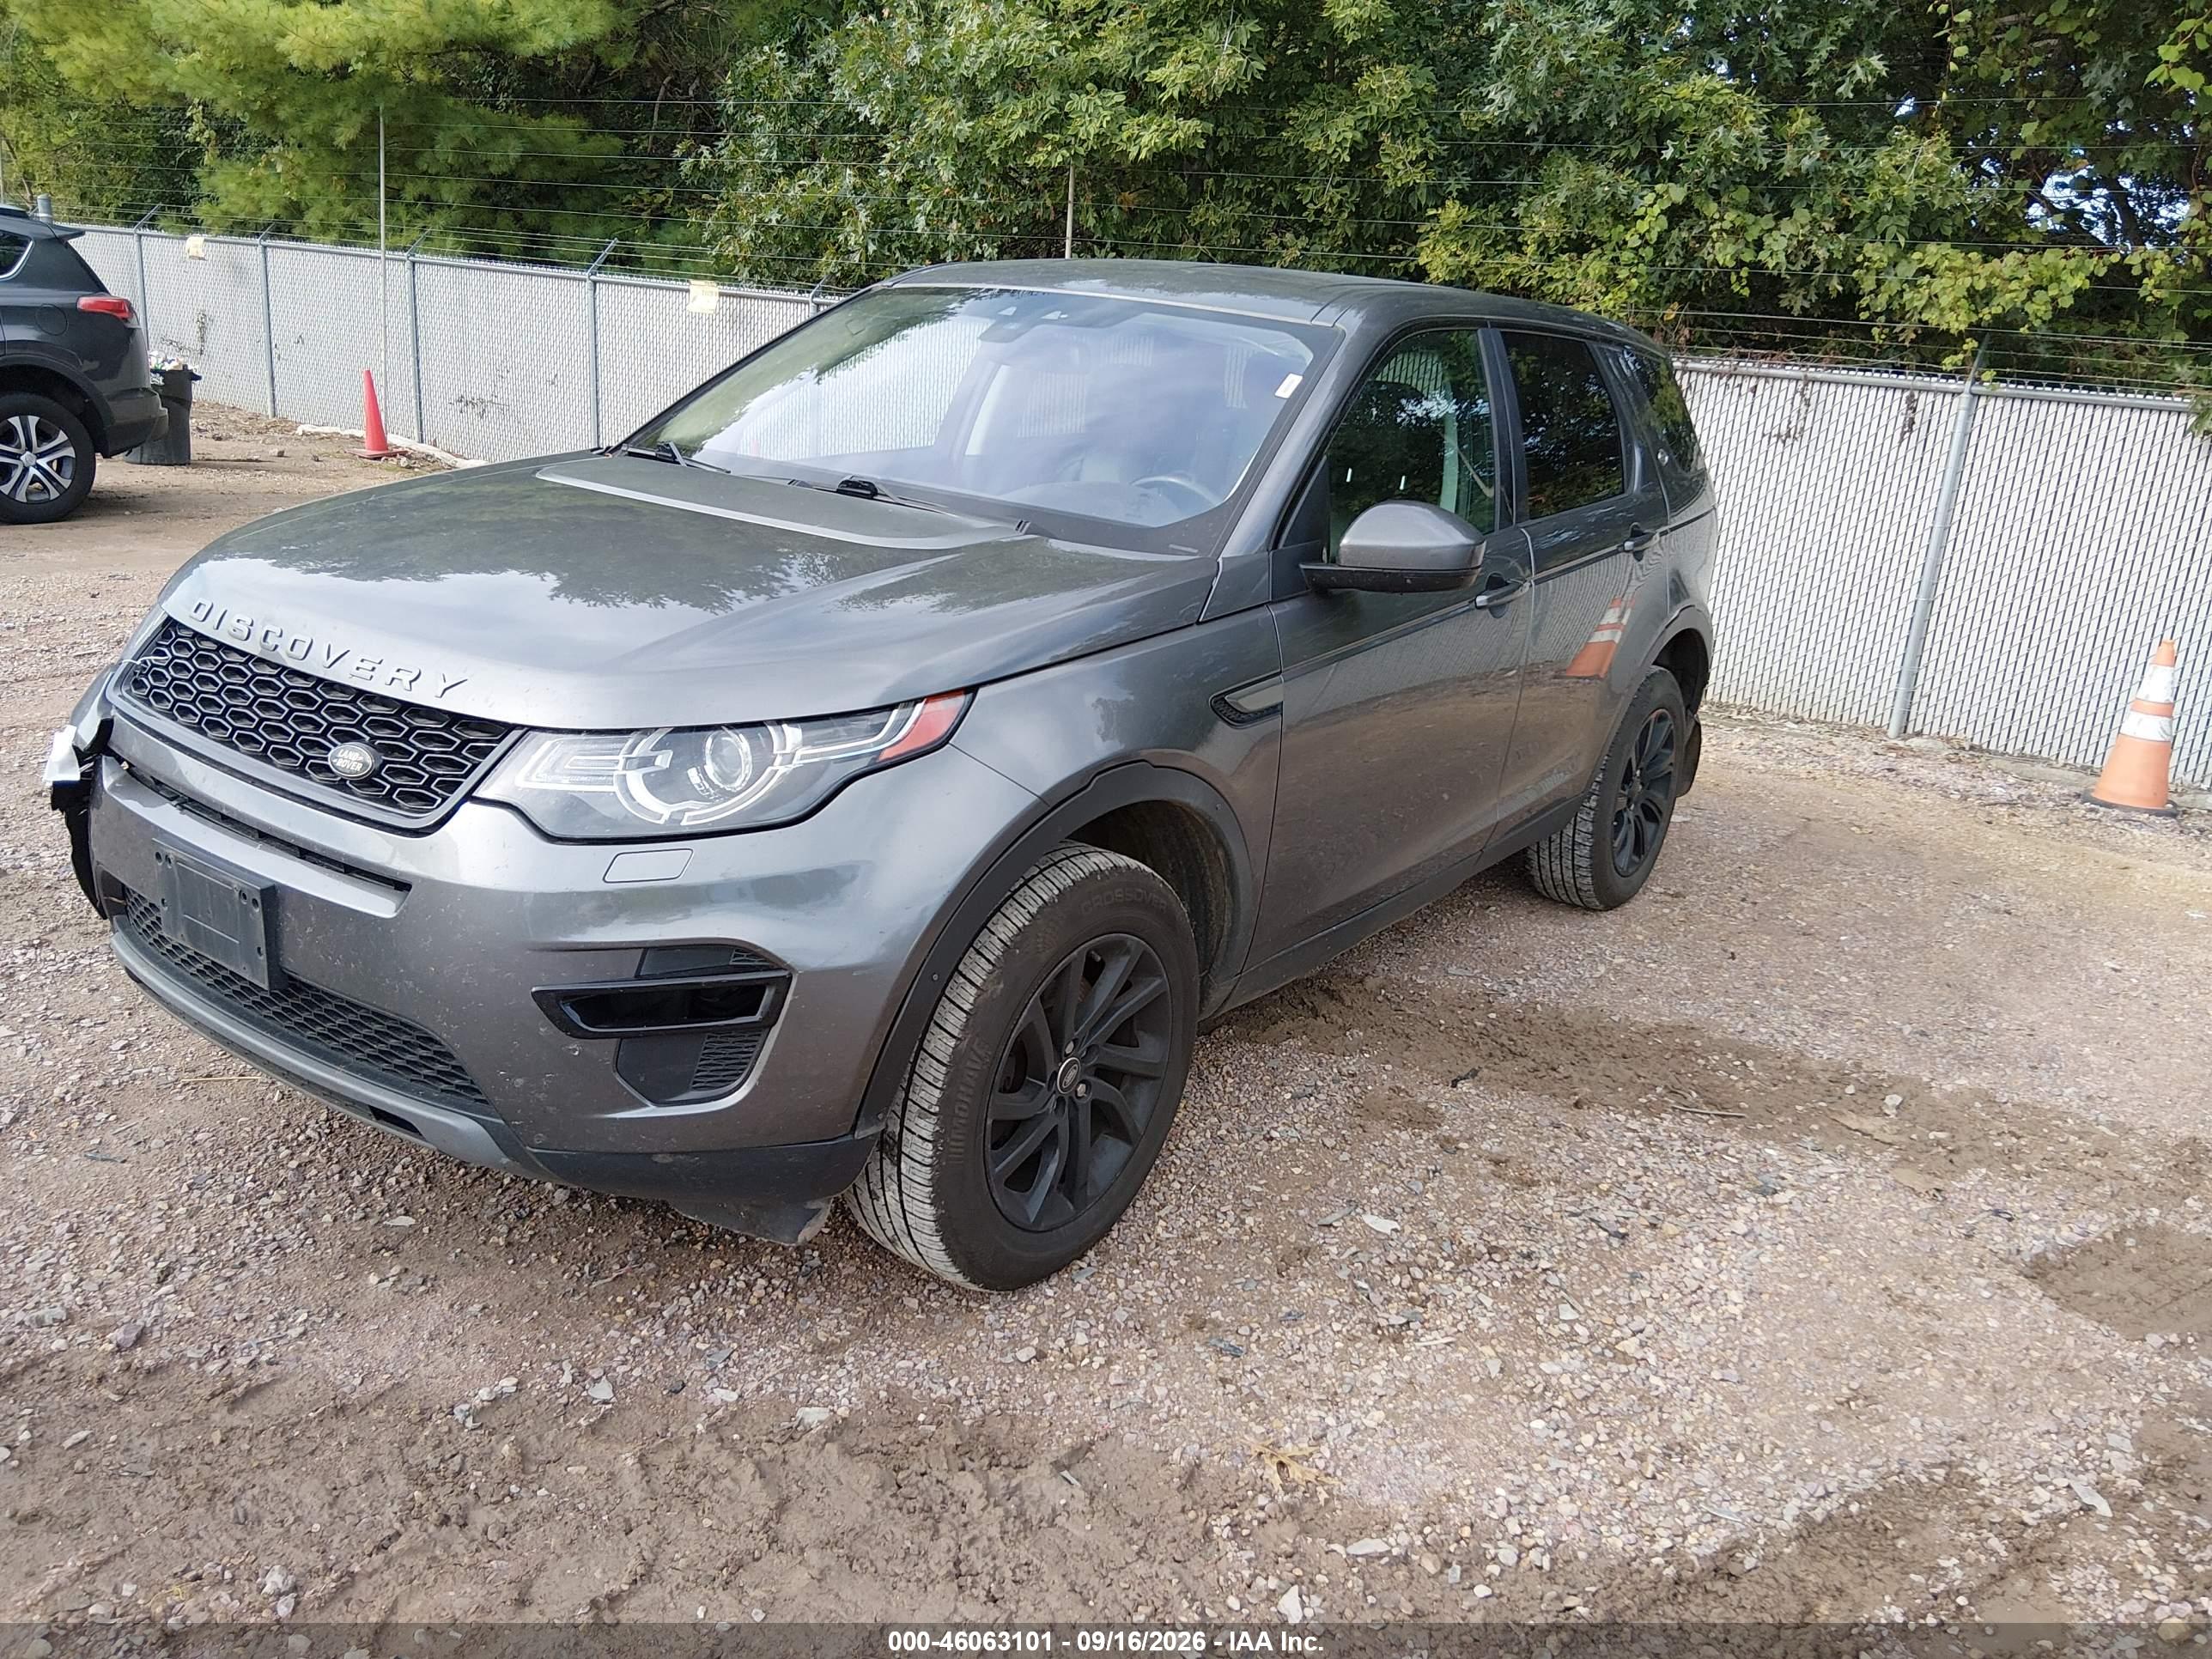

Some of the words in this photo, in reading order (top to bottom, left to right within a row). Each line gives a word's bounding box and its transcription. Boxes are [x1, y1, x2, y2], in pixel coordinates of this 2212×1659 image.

[188, 597, 469, 699] DISCOVERY
[336, 758, 363, 772] ROVER
[337, 749, 360, 761] LAND
[1079, 887, 1169, 915] CROSSOVER
